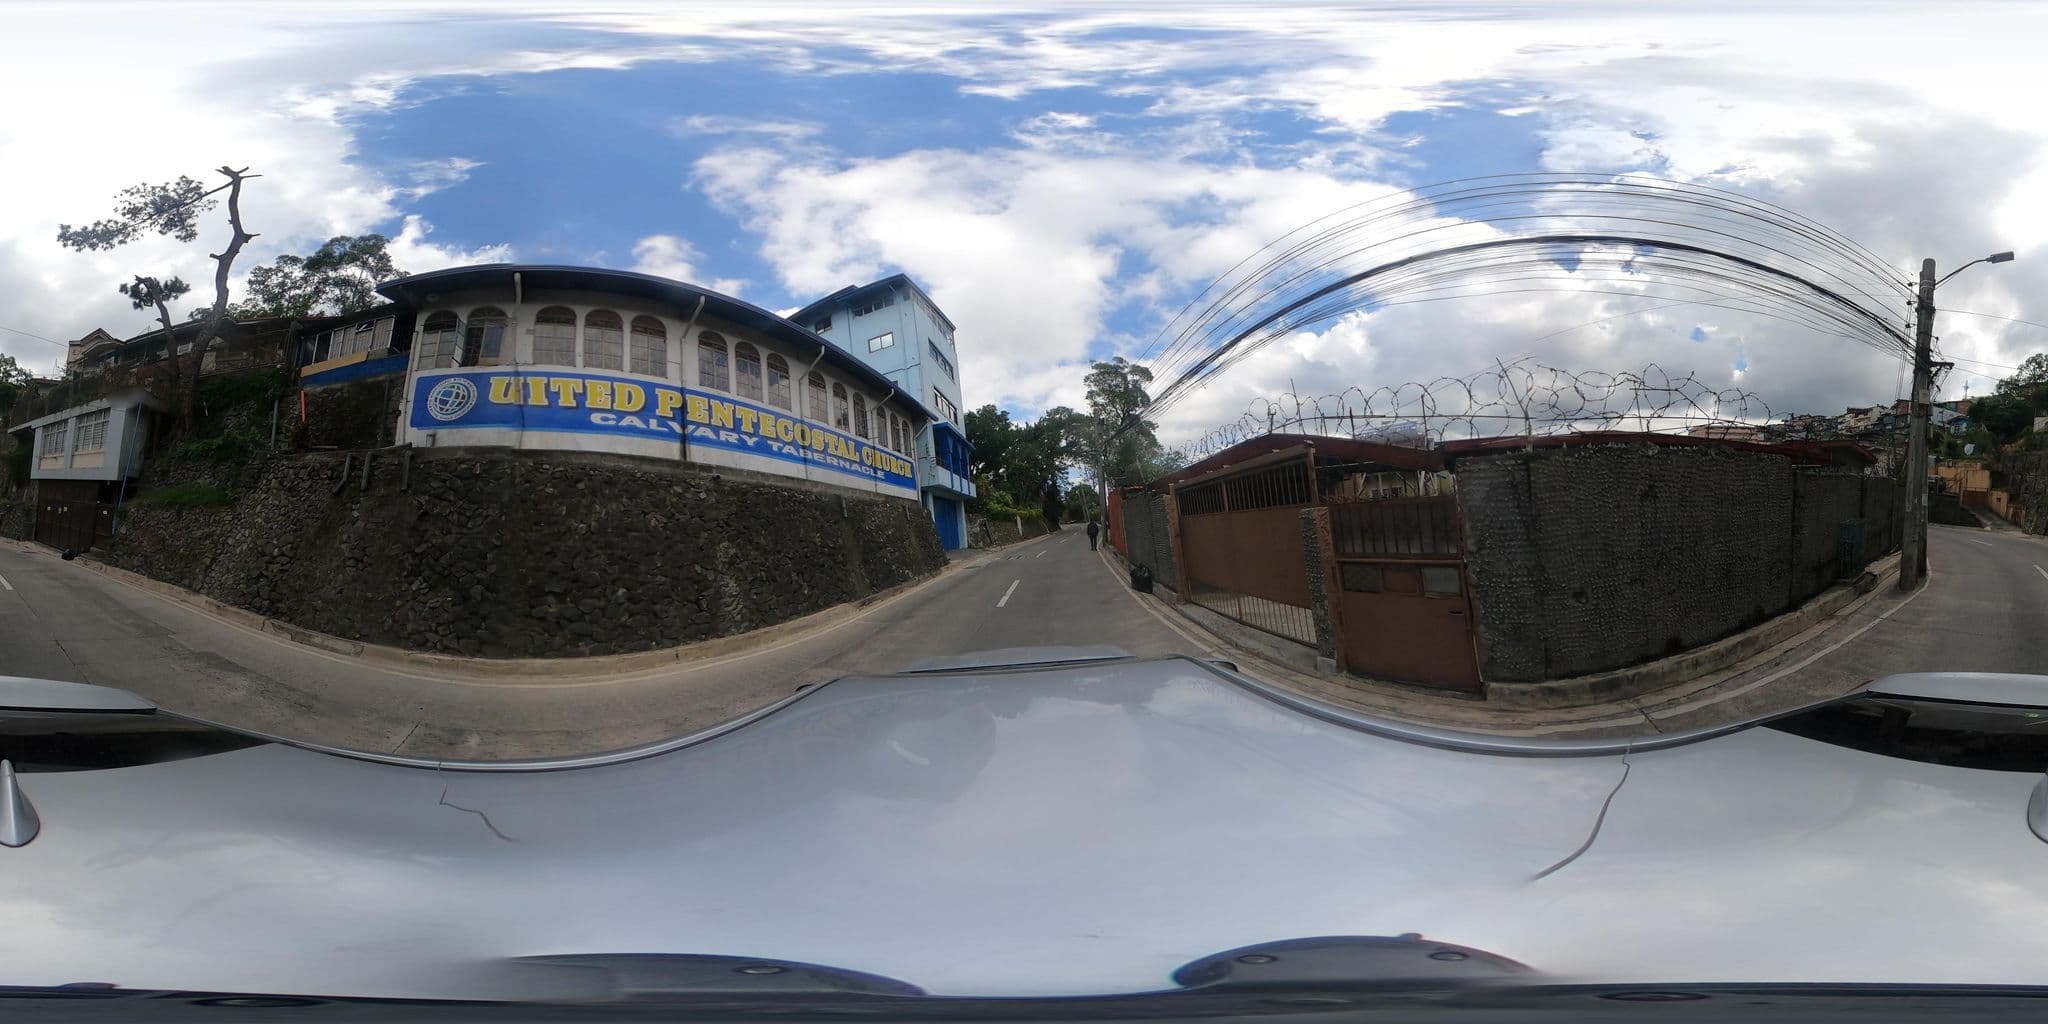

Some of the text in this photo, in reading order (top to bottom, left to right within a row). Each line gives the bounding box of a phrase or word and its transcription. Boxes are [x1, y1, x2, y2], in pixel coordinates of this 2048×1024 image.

[590, 412, 886, 479] CALVARY TABERNACLE
[655, 388, 860, 463] PENTECOSTAL
[861, 446, 913, 478] CHURCH
